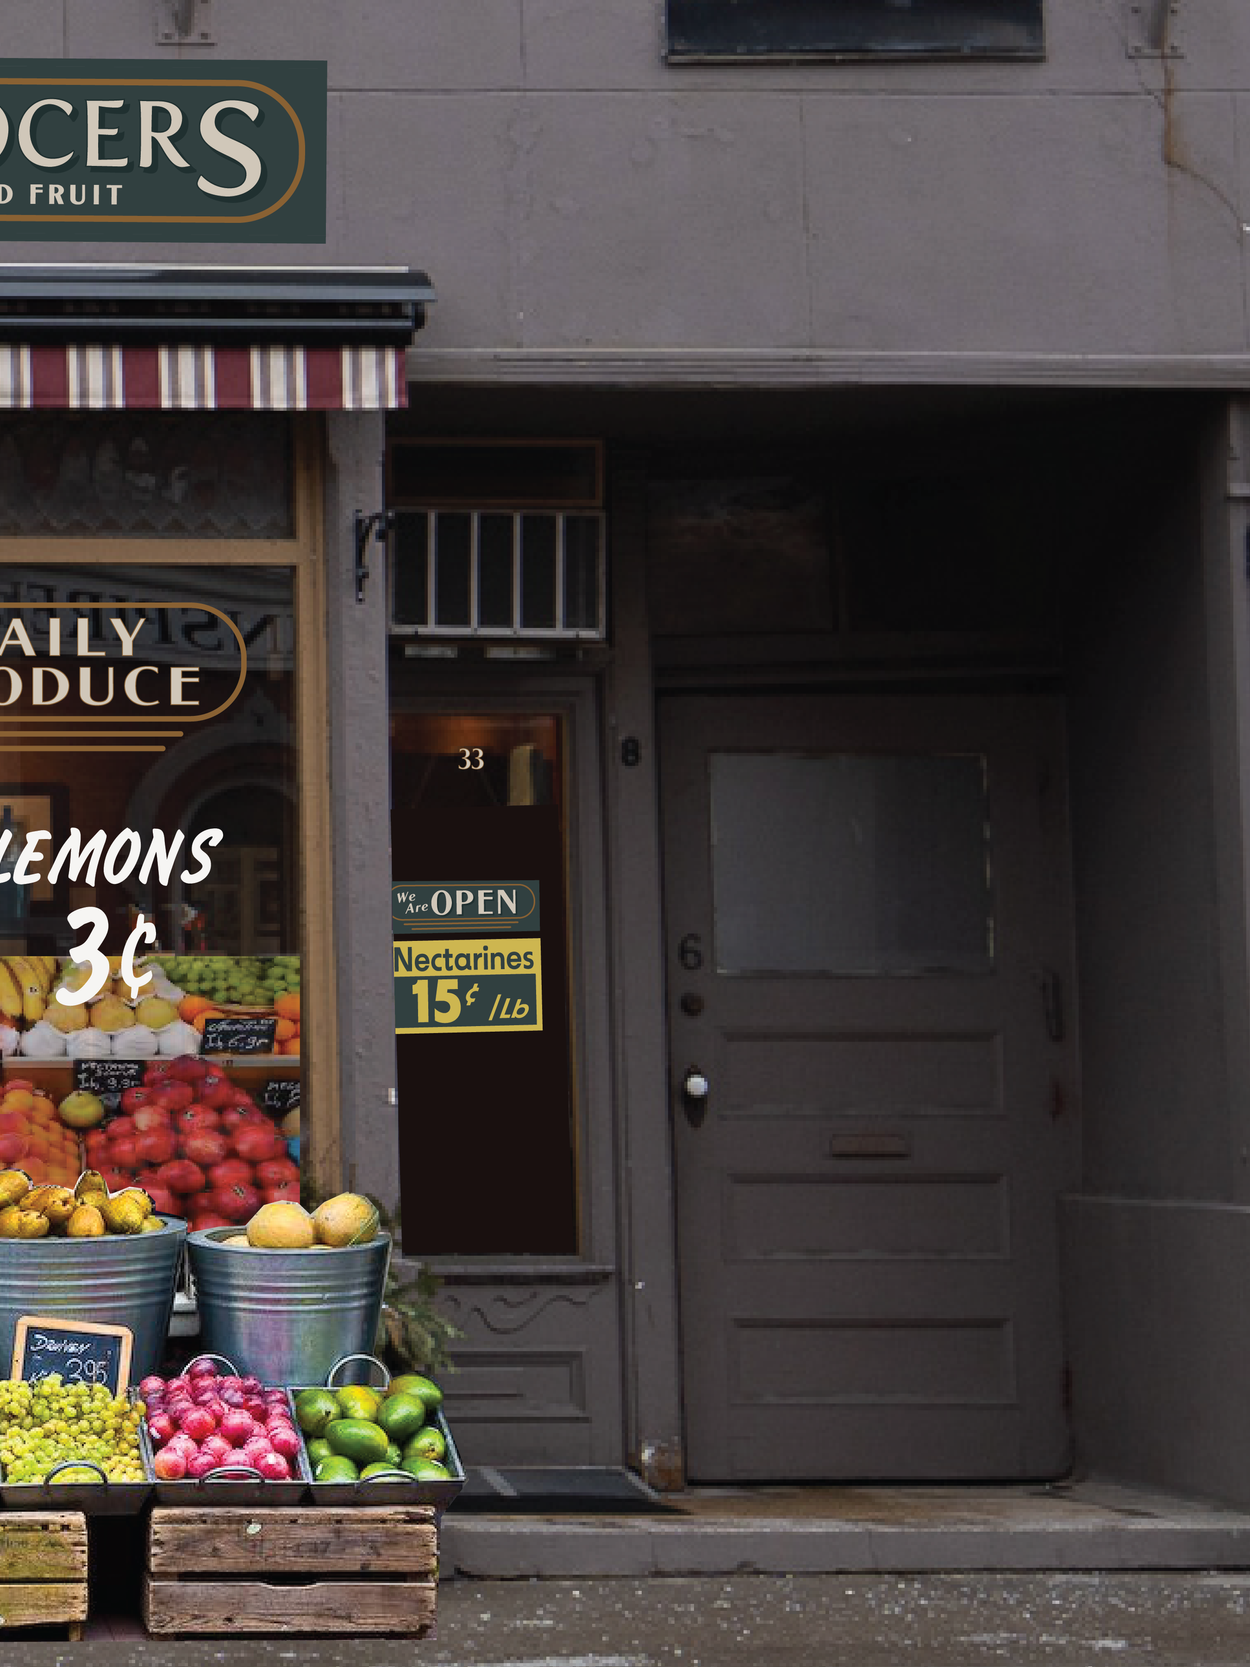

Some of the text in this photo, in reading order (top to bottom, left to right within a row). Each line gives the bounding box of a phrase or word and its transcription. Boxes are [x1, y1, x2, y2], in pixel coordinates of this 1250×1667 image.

[29, 184, 123, 206] FRUIT
[457, 747, 485, 770] 33
[396, 891, 416, 904] We
[404, 901, 429, 915] Are
[430, 889, 517, 916] OPEN
[55, 906, 157, 1007] 3¢
[394, 945, 535, 973] Nectarines
[677, 933, 704, 970] 6
